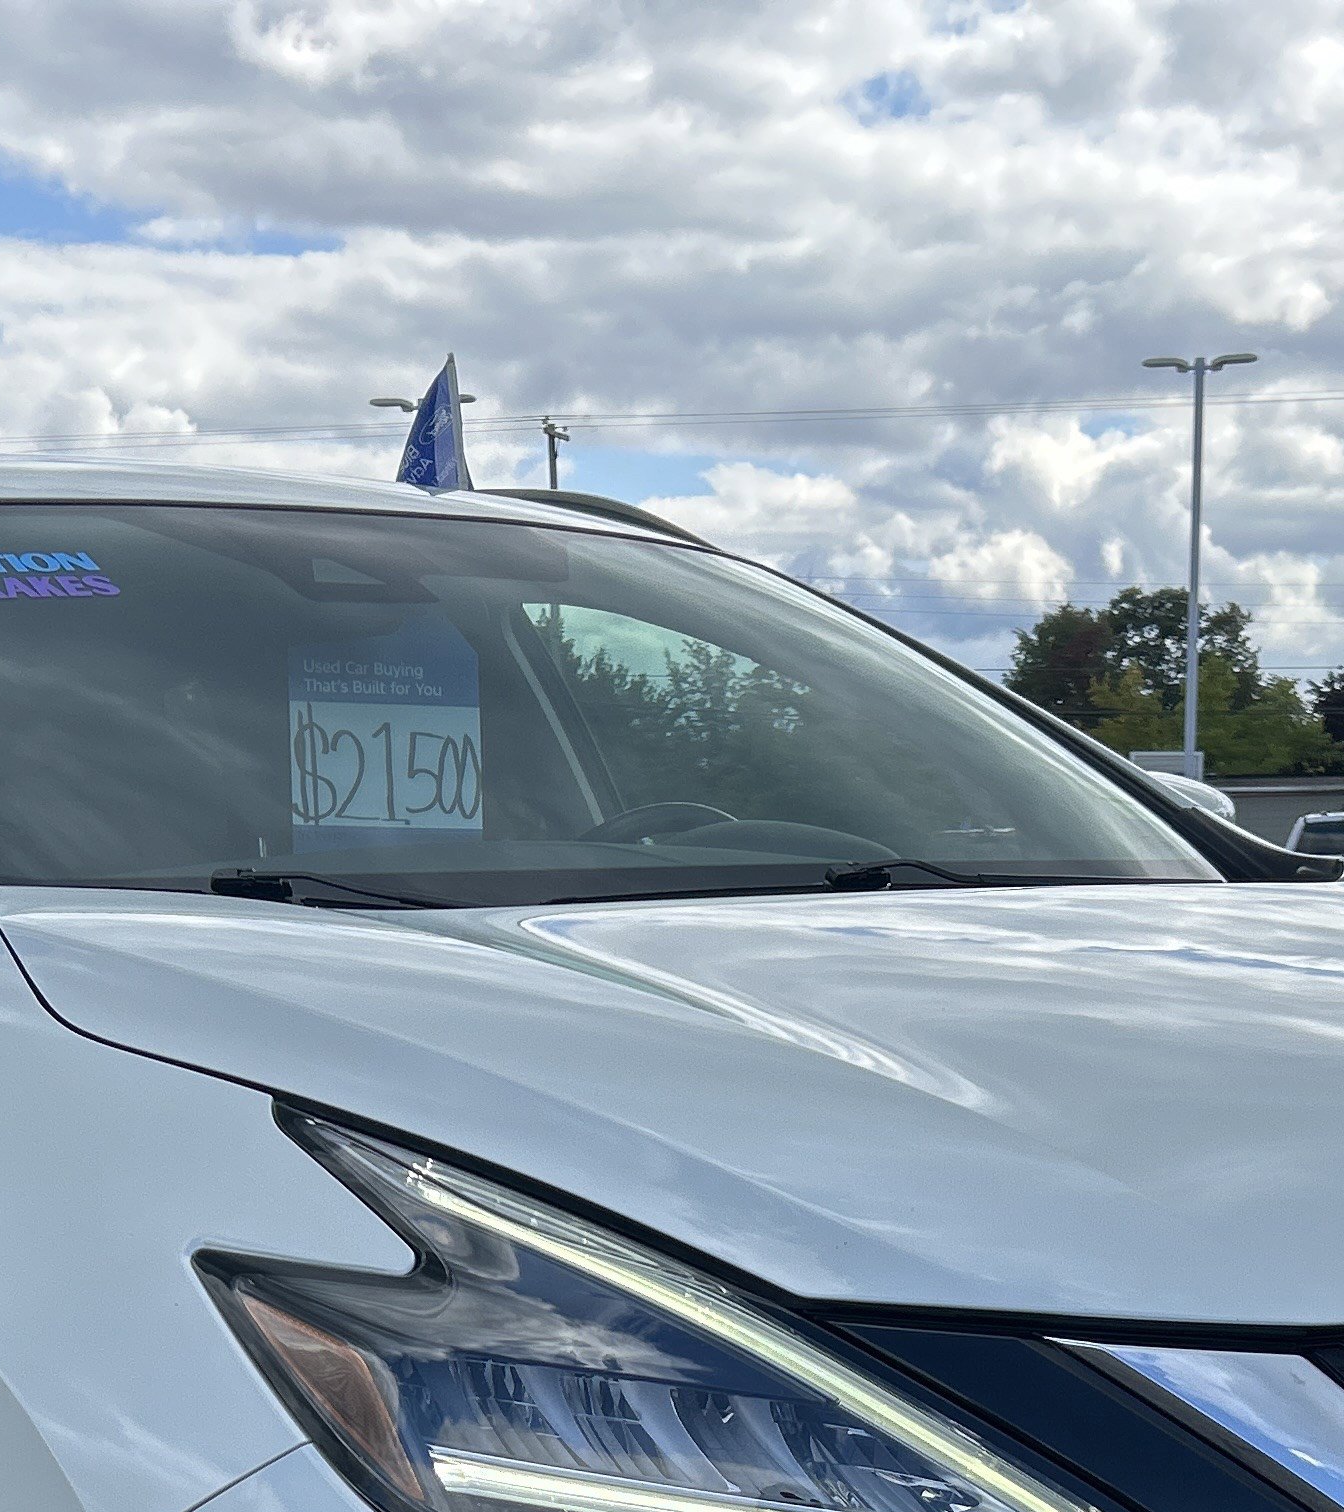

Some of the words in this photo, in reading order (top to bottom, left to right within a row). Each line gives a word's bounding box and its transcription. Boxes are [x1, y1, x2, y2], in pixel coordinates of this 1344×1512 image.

[303, 658, 340, 674] Used
[345, 662, 368, 675] Car
[374, 662, 424, 679] Buying
[305, 678, 349, 693] That's
[353, 680, 386, 694] Built
[390, 682, 411, 695] for
[416, 683, 443, 697] You
[292, 702, 483, 826] $21500
